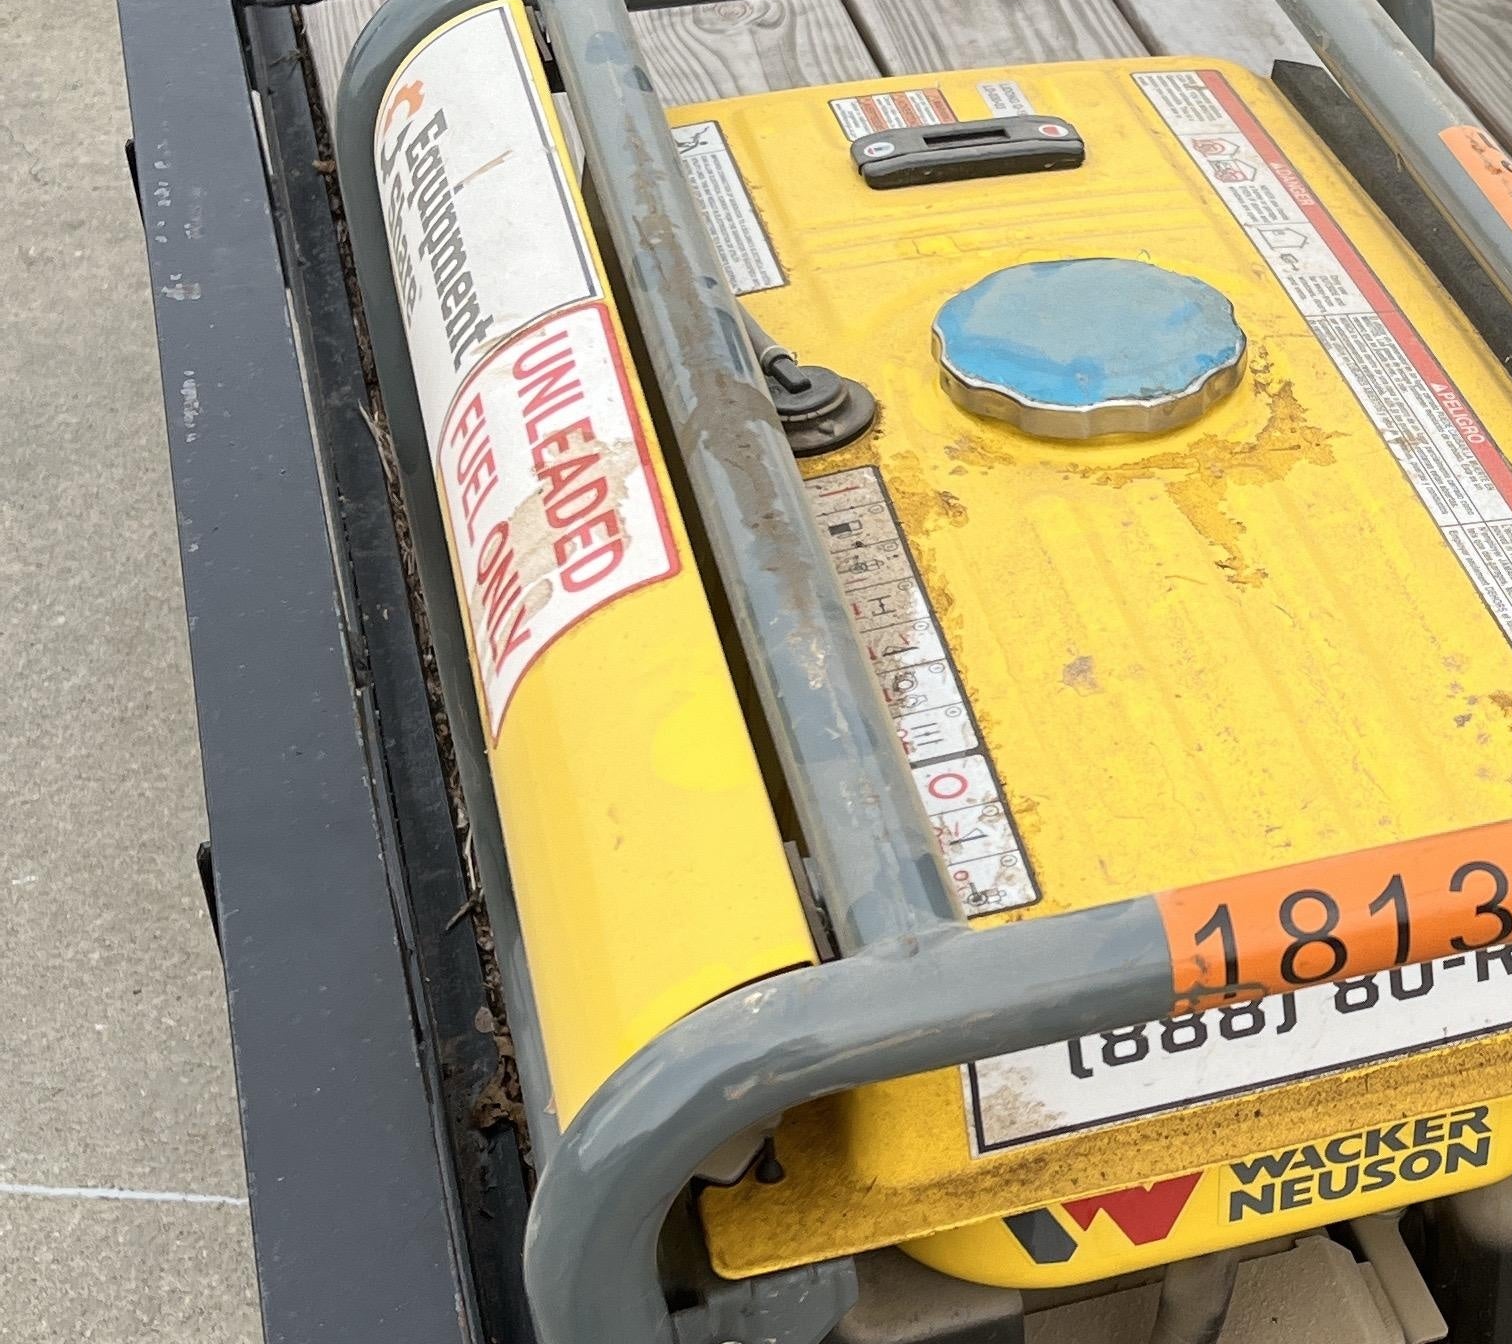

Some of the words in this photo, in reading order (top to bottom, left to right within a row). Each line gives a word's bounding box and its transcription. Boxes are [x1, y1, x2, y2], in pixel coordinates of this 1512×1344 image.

[405, 108, 493, 373] Equipment
[512, 330, 624, 593] UNLEADED
[1435, 392, 1487, 444] PELIGRO
[450, 392, 499, 547] FUEL
[477, 520, 532, 676] ONLY
[1229, 1104, 1492, 1185] WACKER
[1229, 1136, 1491, 1223] NEUSON
